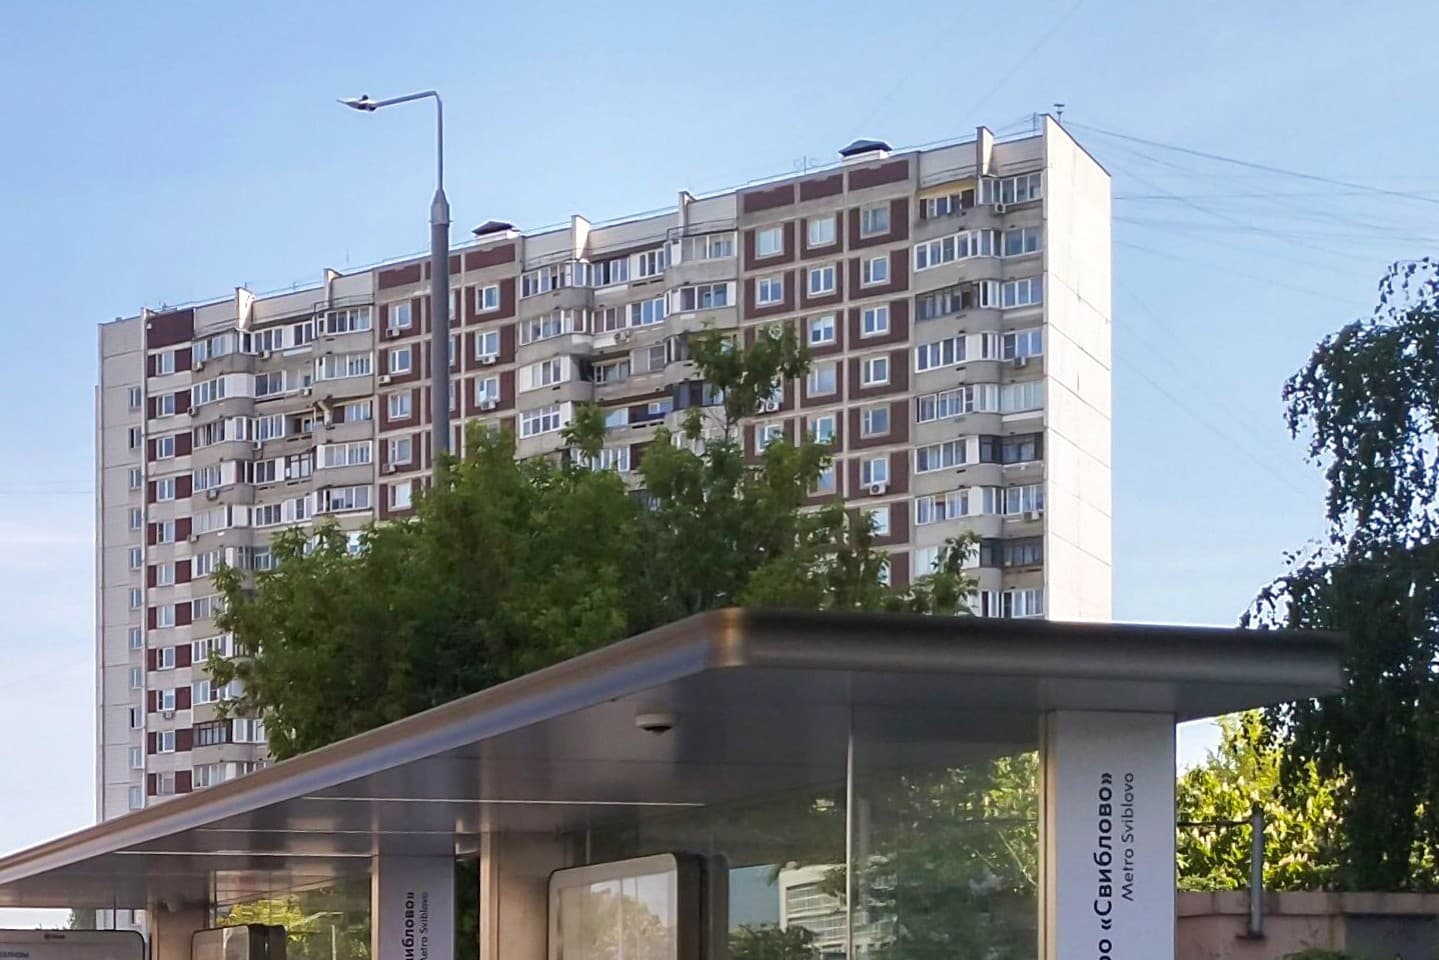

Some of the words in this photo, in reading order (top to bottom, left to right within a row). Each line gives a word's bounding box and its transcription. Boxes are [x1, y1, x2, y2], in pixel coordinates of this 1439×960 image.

[1120, 772, 1134, 843] Sviblovo
[1093, 772, 1113, 930] «Свиблово»
[1121, 848, 1134, 901] Metro
